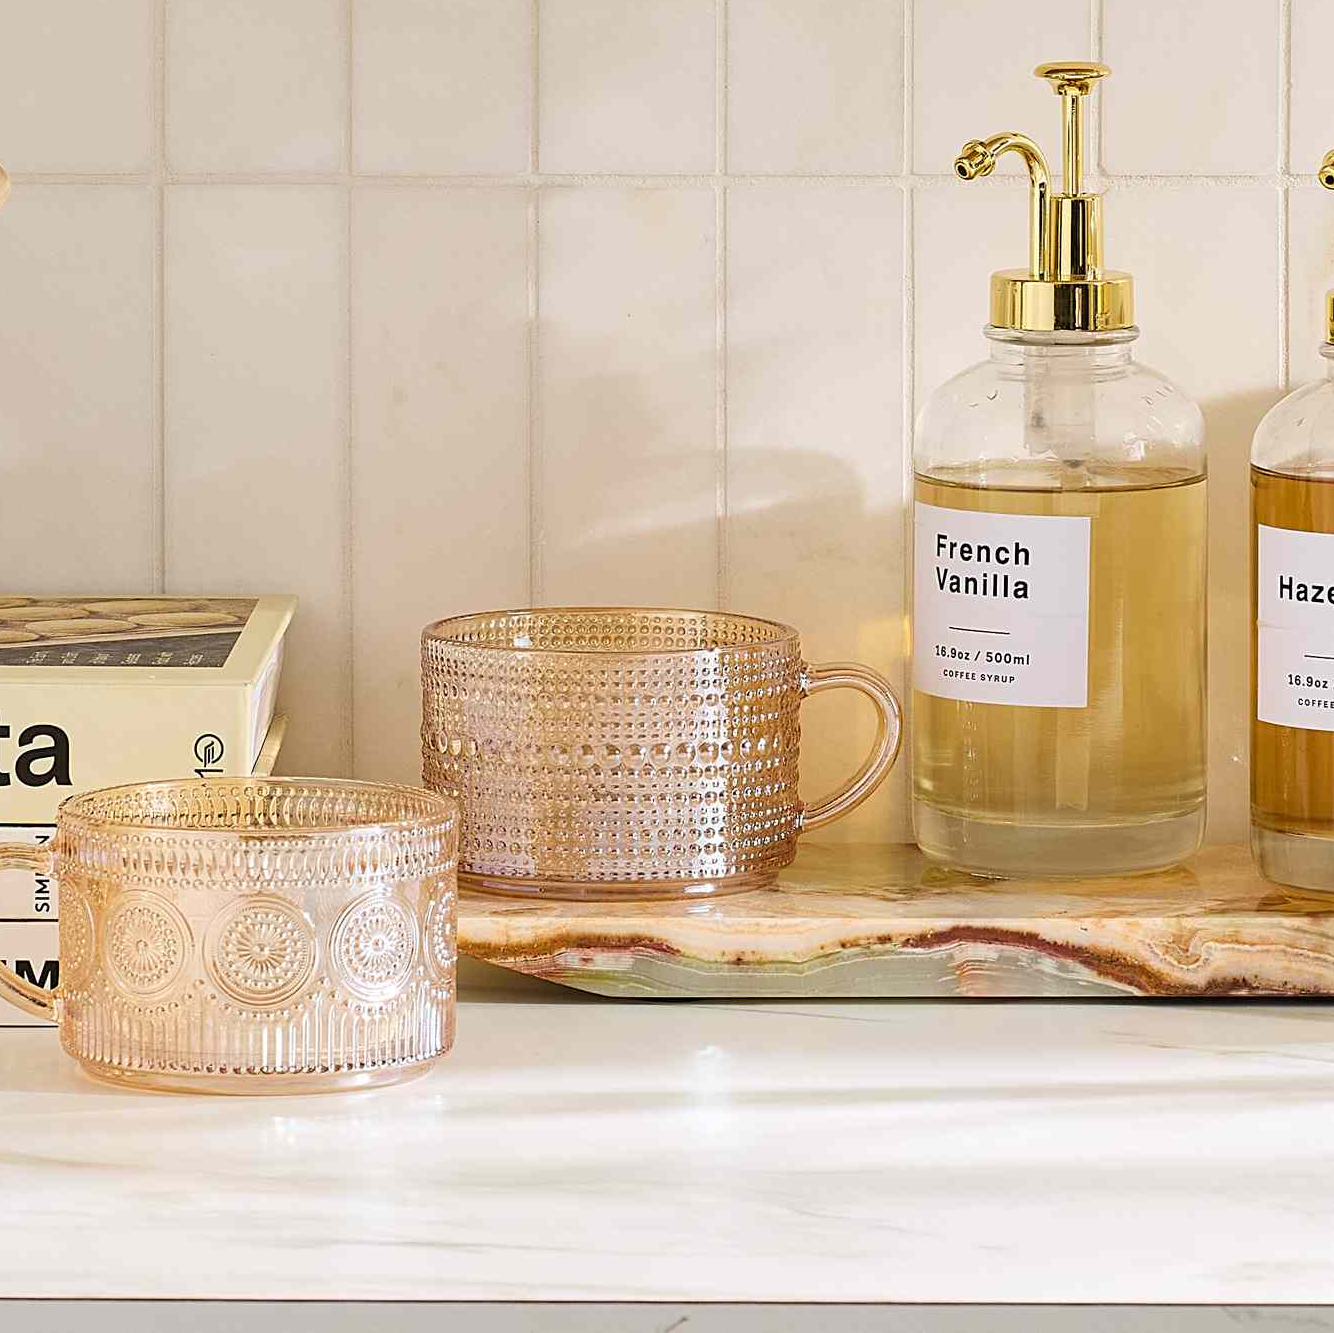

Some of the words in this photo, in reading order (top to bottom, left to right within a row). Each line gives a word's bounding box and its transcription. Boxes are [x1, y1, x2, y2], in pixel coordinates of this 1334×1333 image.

[936, 533, 1030, 566] French
[935, 566, 1029, 599] Vanilla
[935, 644, 970, 662] 16.9oz
[986, 651, 1030, 665] 500ml
[943, 668, 976, 681] COFFEE
[980, 673, 1015, 684] SYRUP
[1287, 673, 1328, 689] 16.9oz
[1297, 698, 1334, 709] COFFEE
